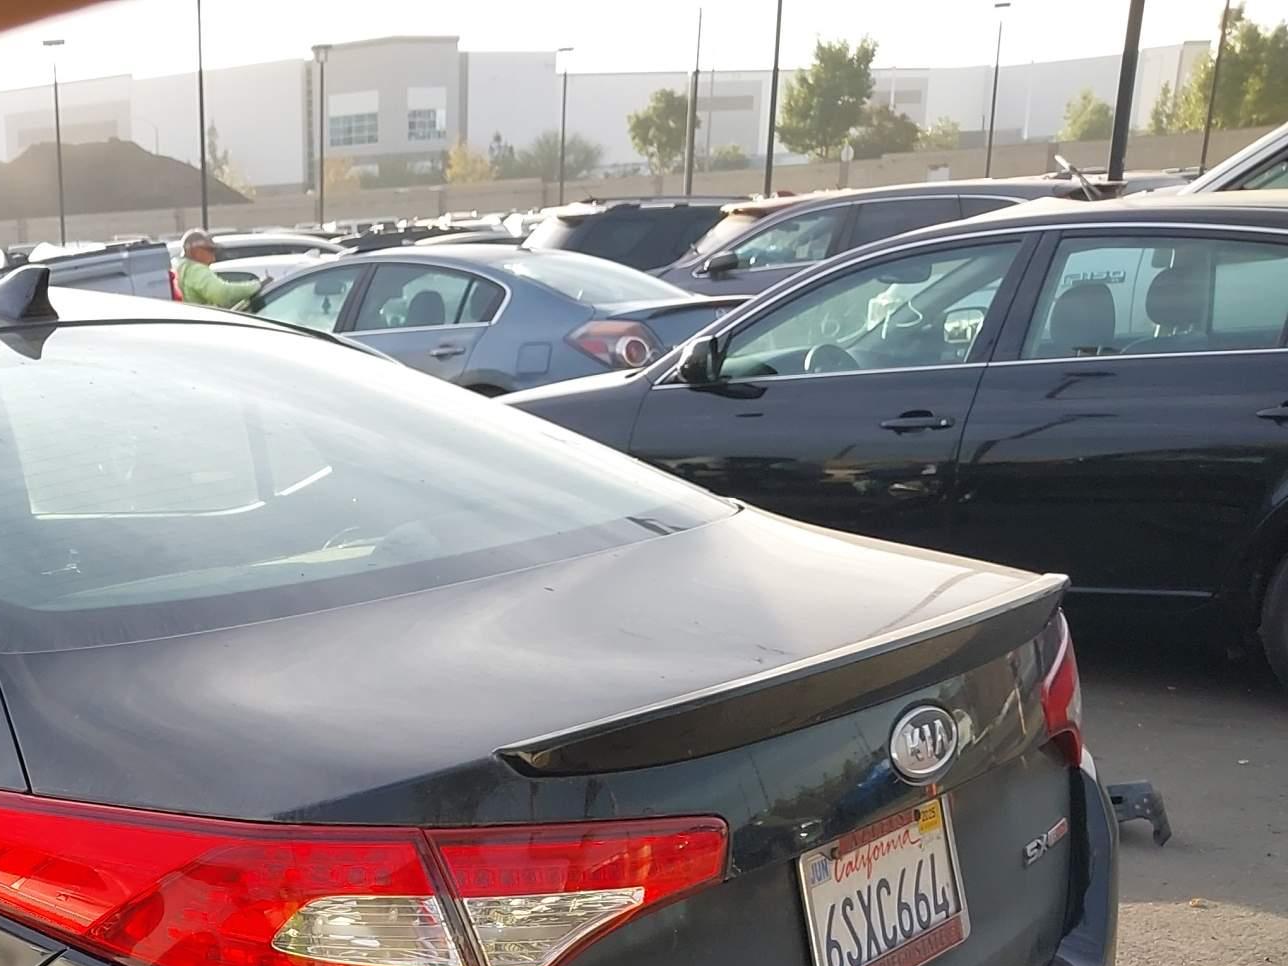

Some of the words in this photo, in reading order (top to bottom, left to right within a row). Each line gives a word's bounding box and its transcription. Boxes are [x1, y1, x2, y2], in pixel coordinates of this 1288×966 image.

[902, 719, 952, 761] KIA
[810, 857, 829, 885] JUN
[834, 828, 921, 883] California
